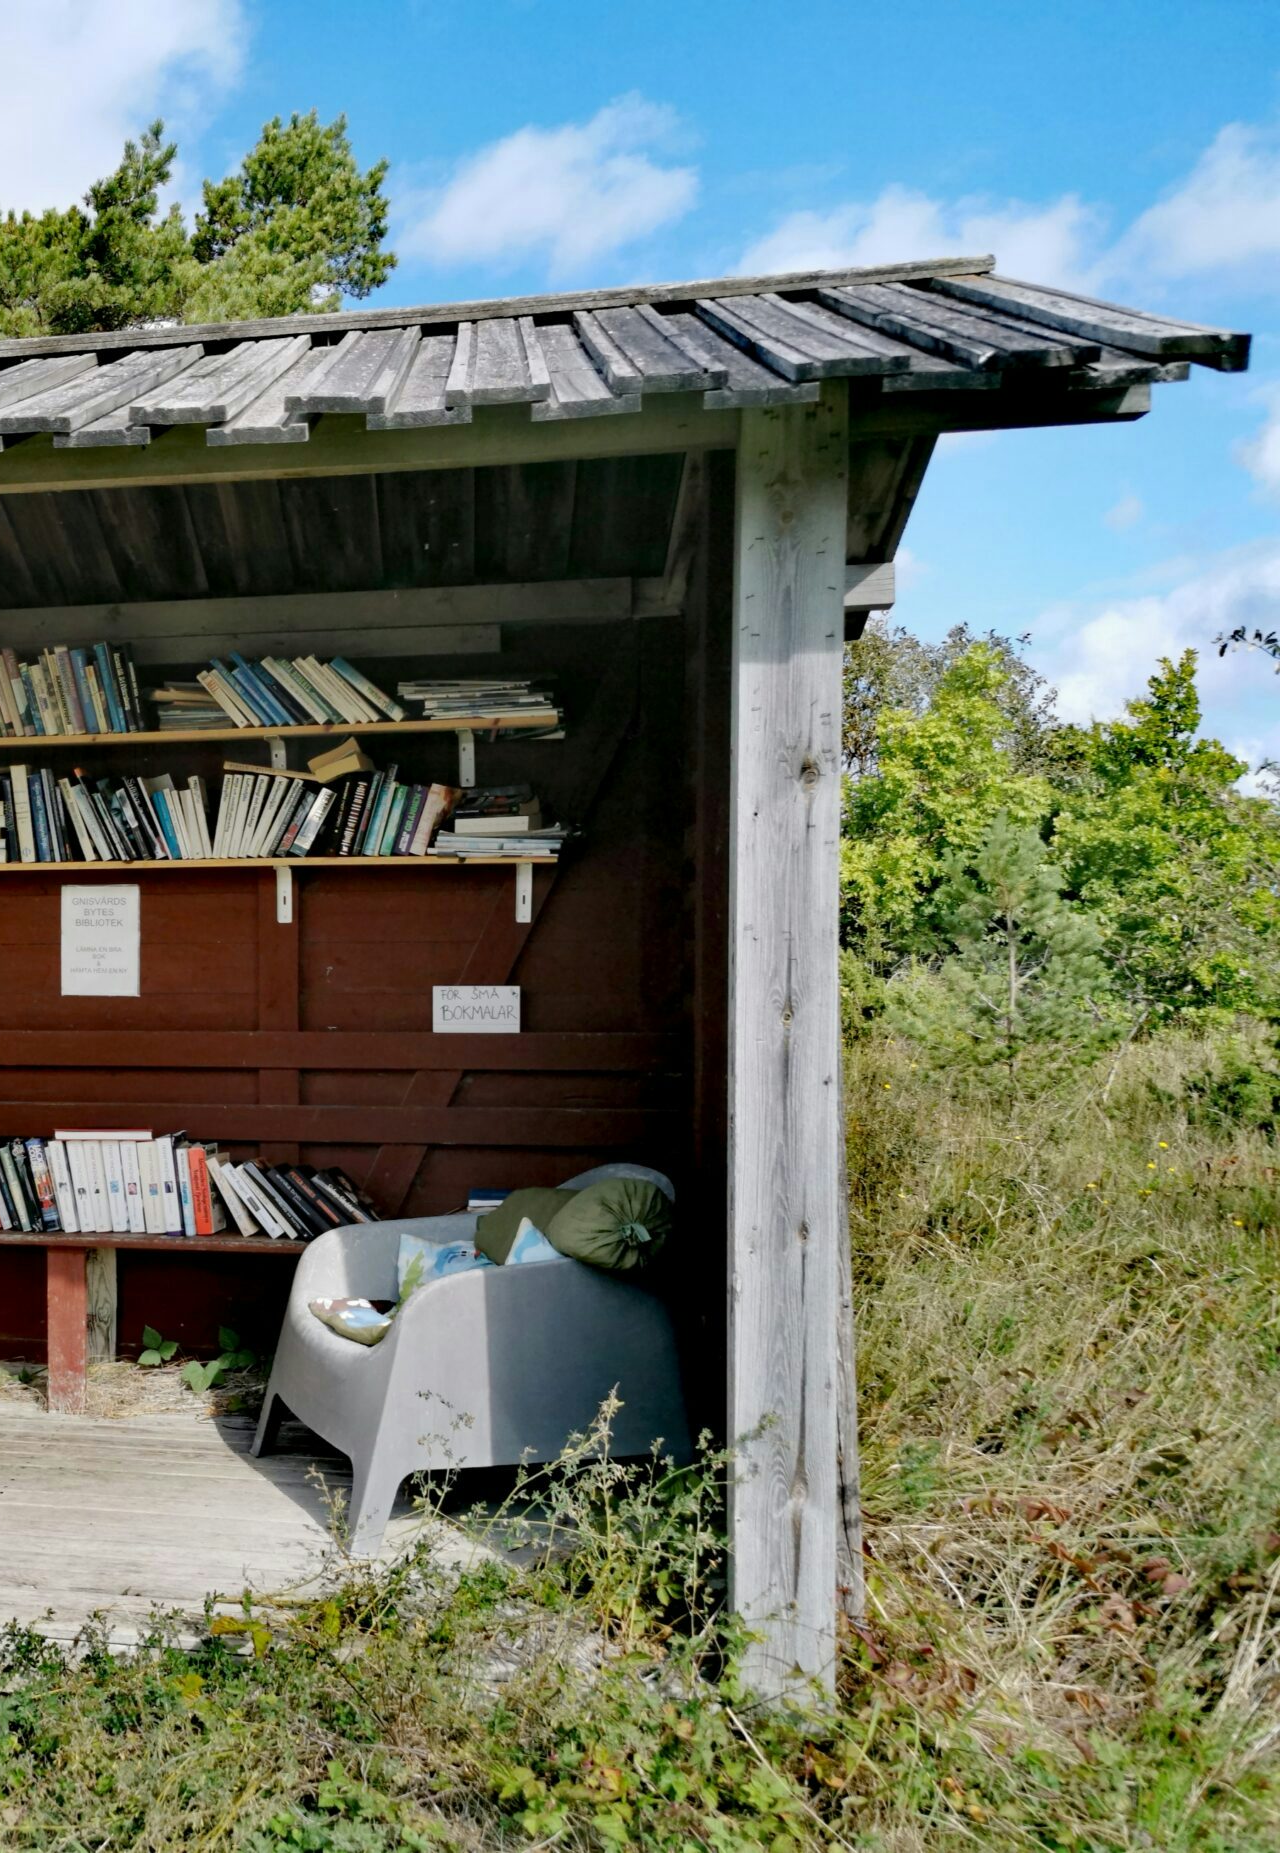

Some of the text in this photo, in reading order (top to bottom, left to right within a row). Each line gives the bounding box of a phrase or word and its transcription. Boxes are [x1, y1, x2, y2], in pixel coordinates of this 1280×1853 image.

[83, 908, 115, 916] BYTES
[75, 918, 124, 927] BIBLIOTEK
[440, 1004, 518, 1021] BOKMALAR
